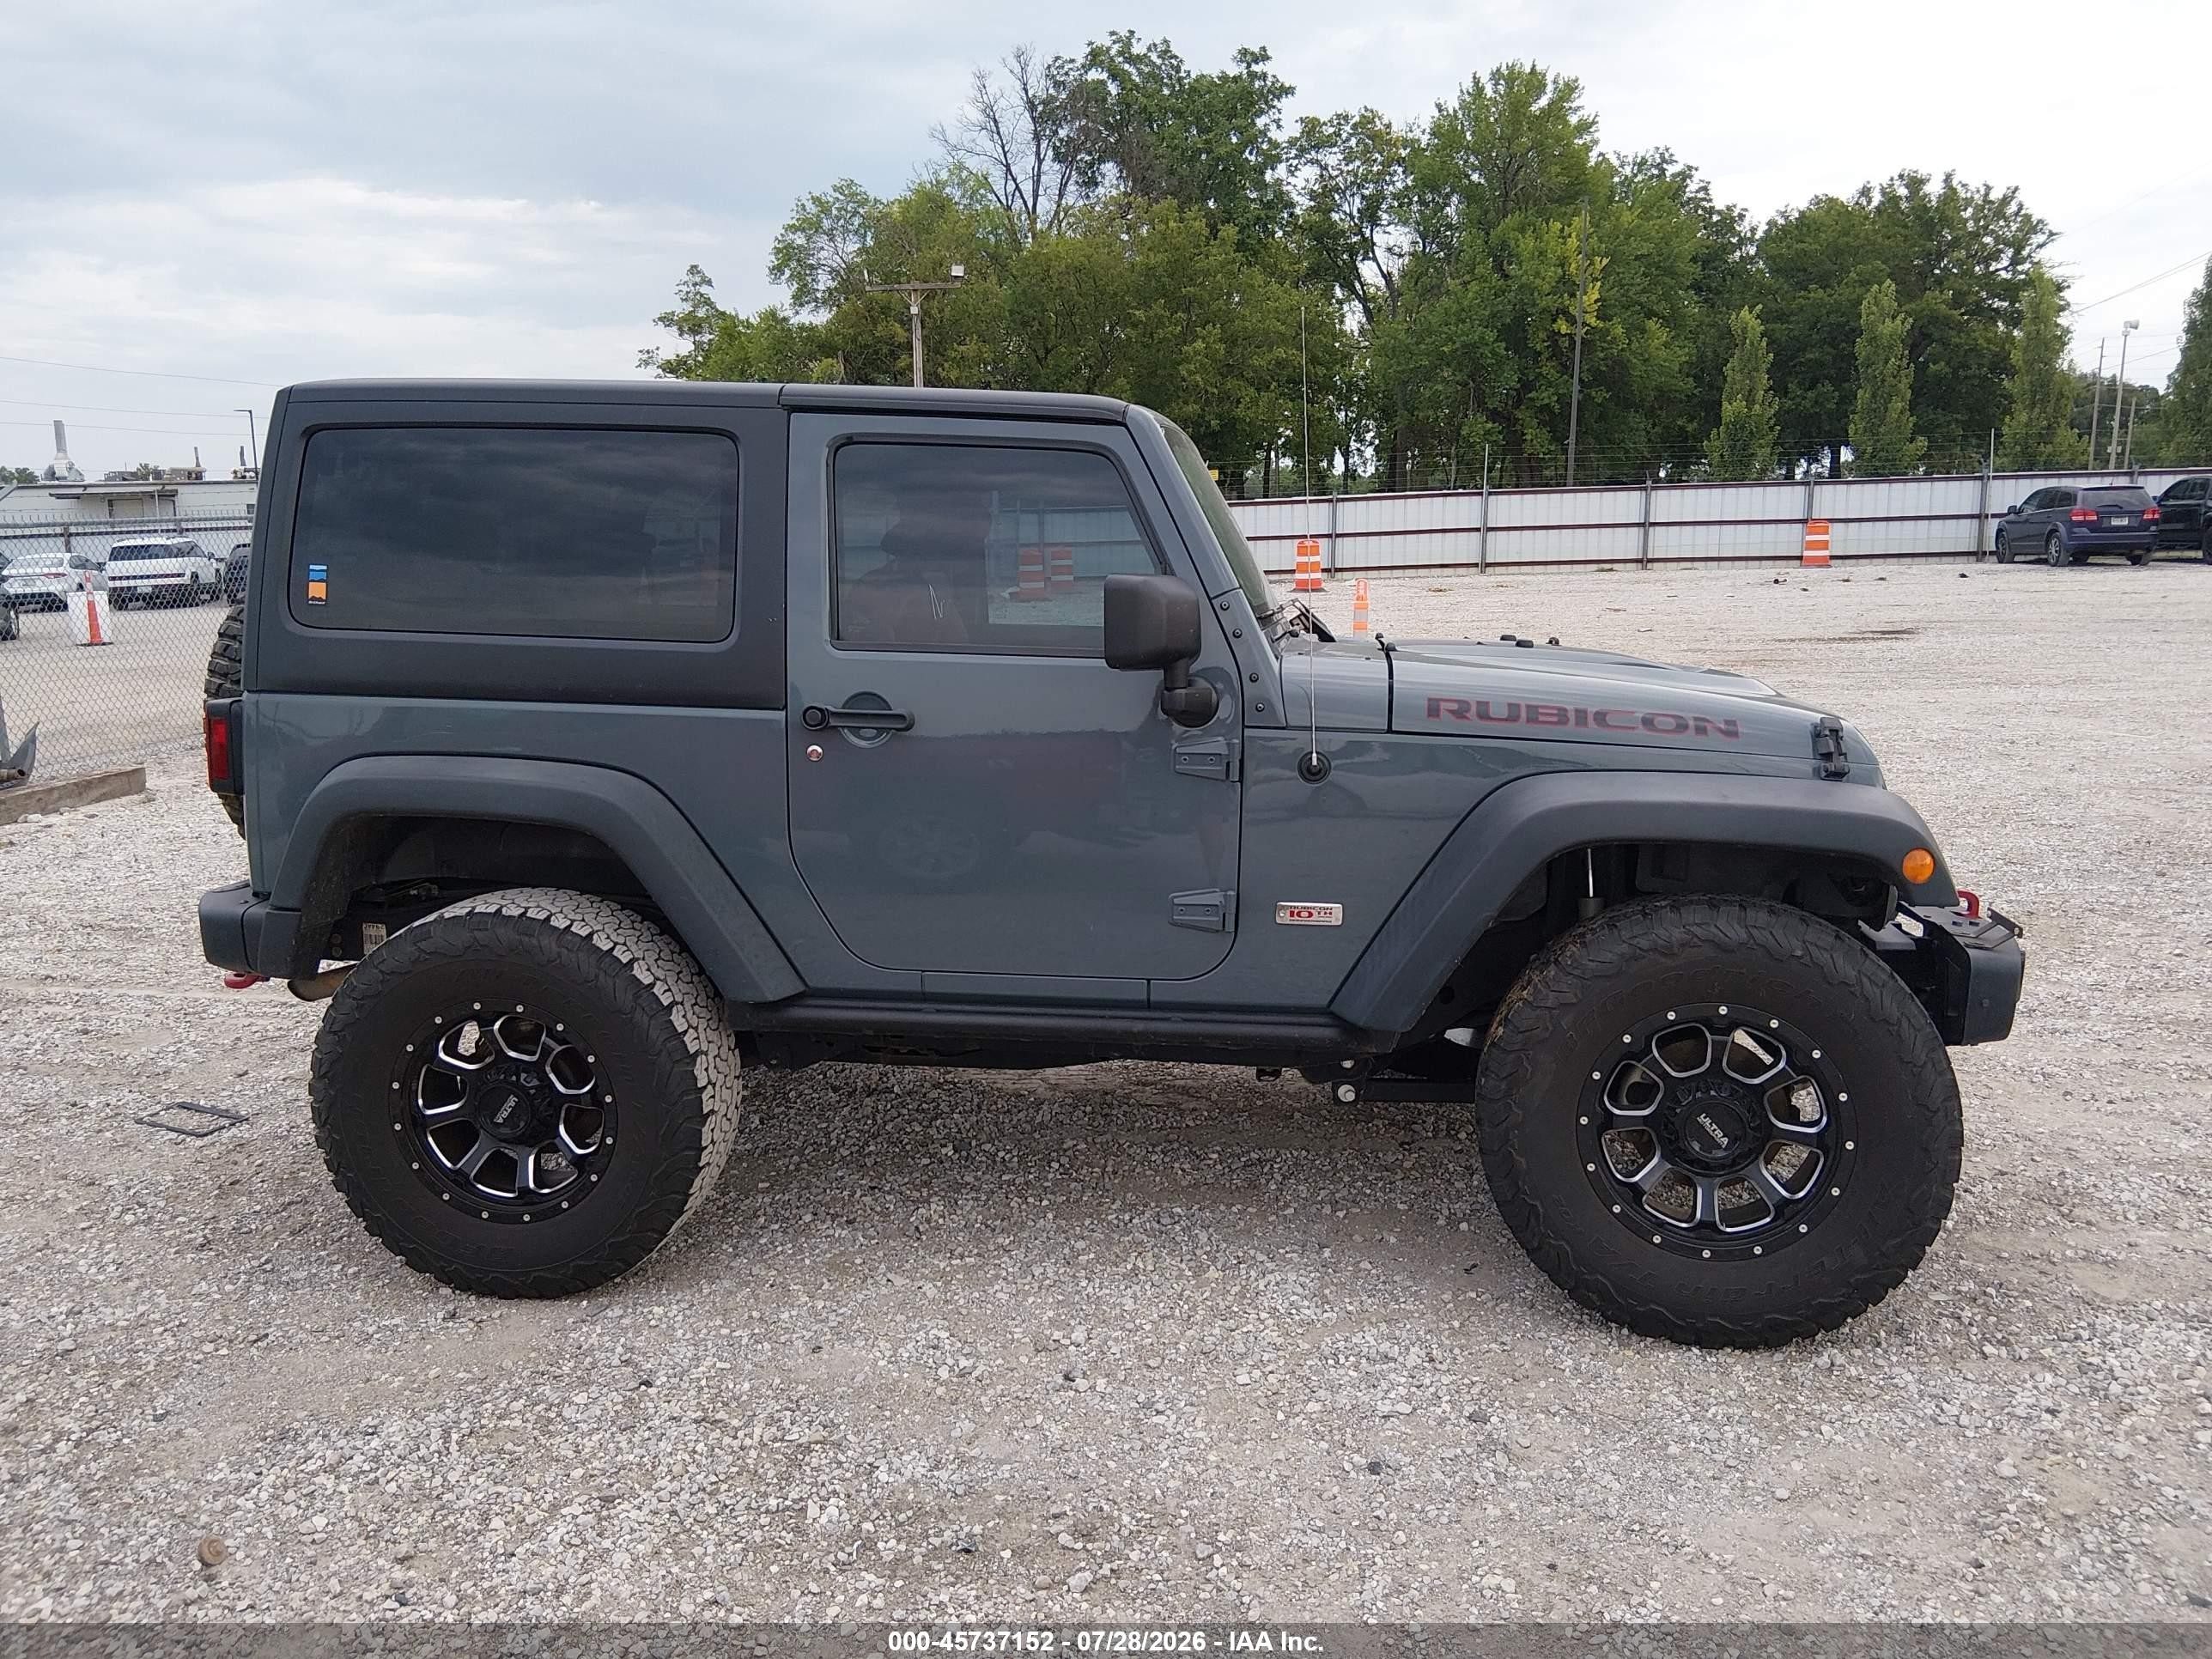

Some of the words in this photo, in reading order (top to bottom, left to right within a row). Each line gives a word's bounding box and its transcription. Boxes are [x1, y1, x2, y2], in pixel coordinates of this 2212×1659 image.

[1425, 696, 1740, 740] RUBICON
[493, 1097, 519, 1123] ULTRA
[1699, 1113, 1729, 1148] ULTRA
